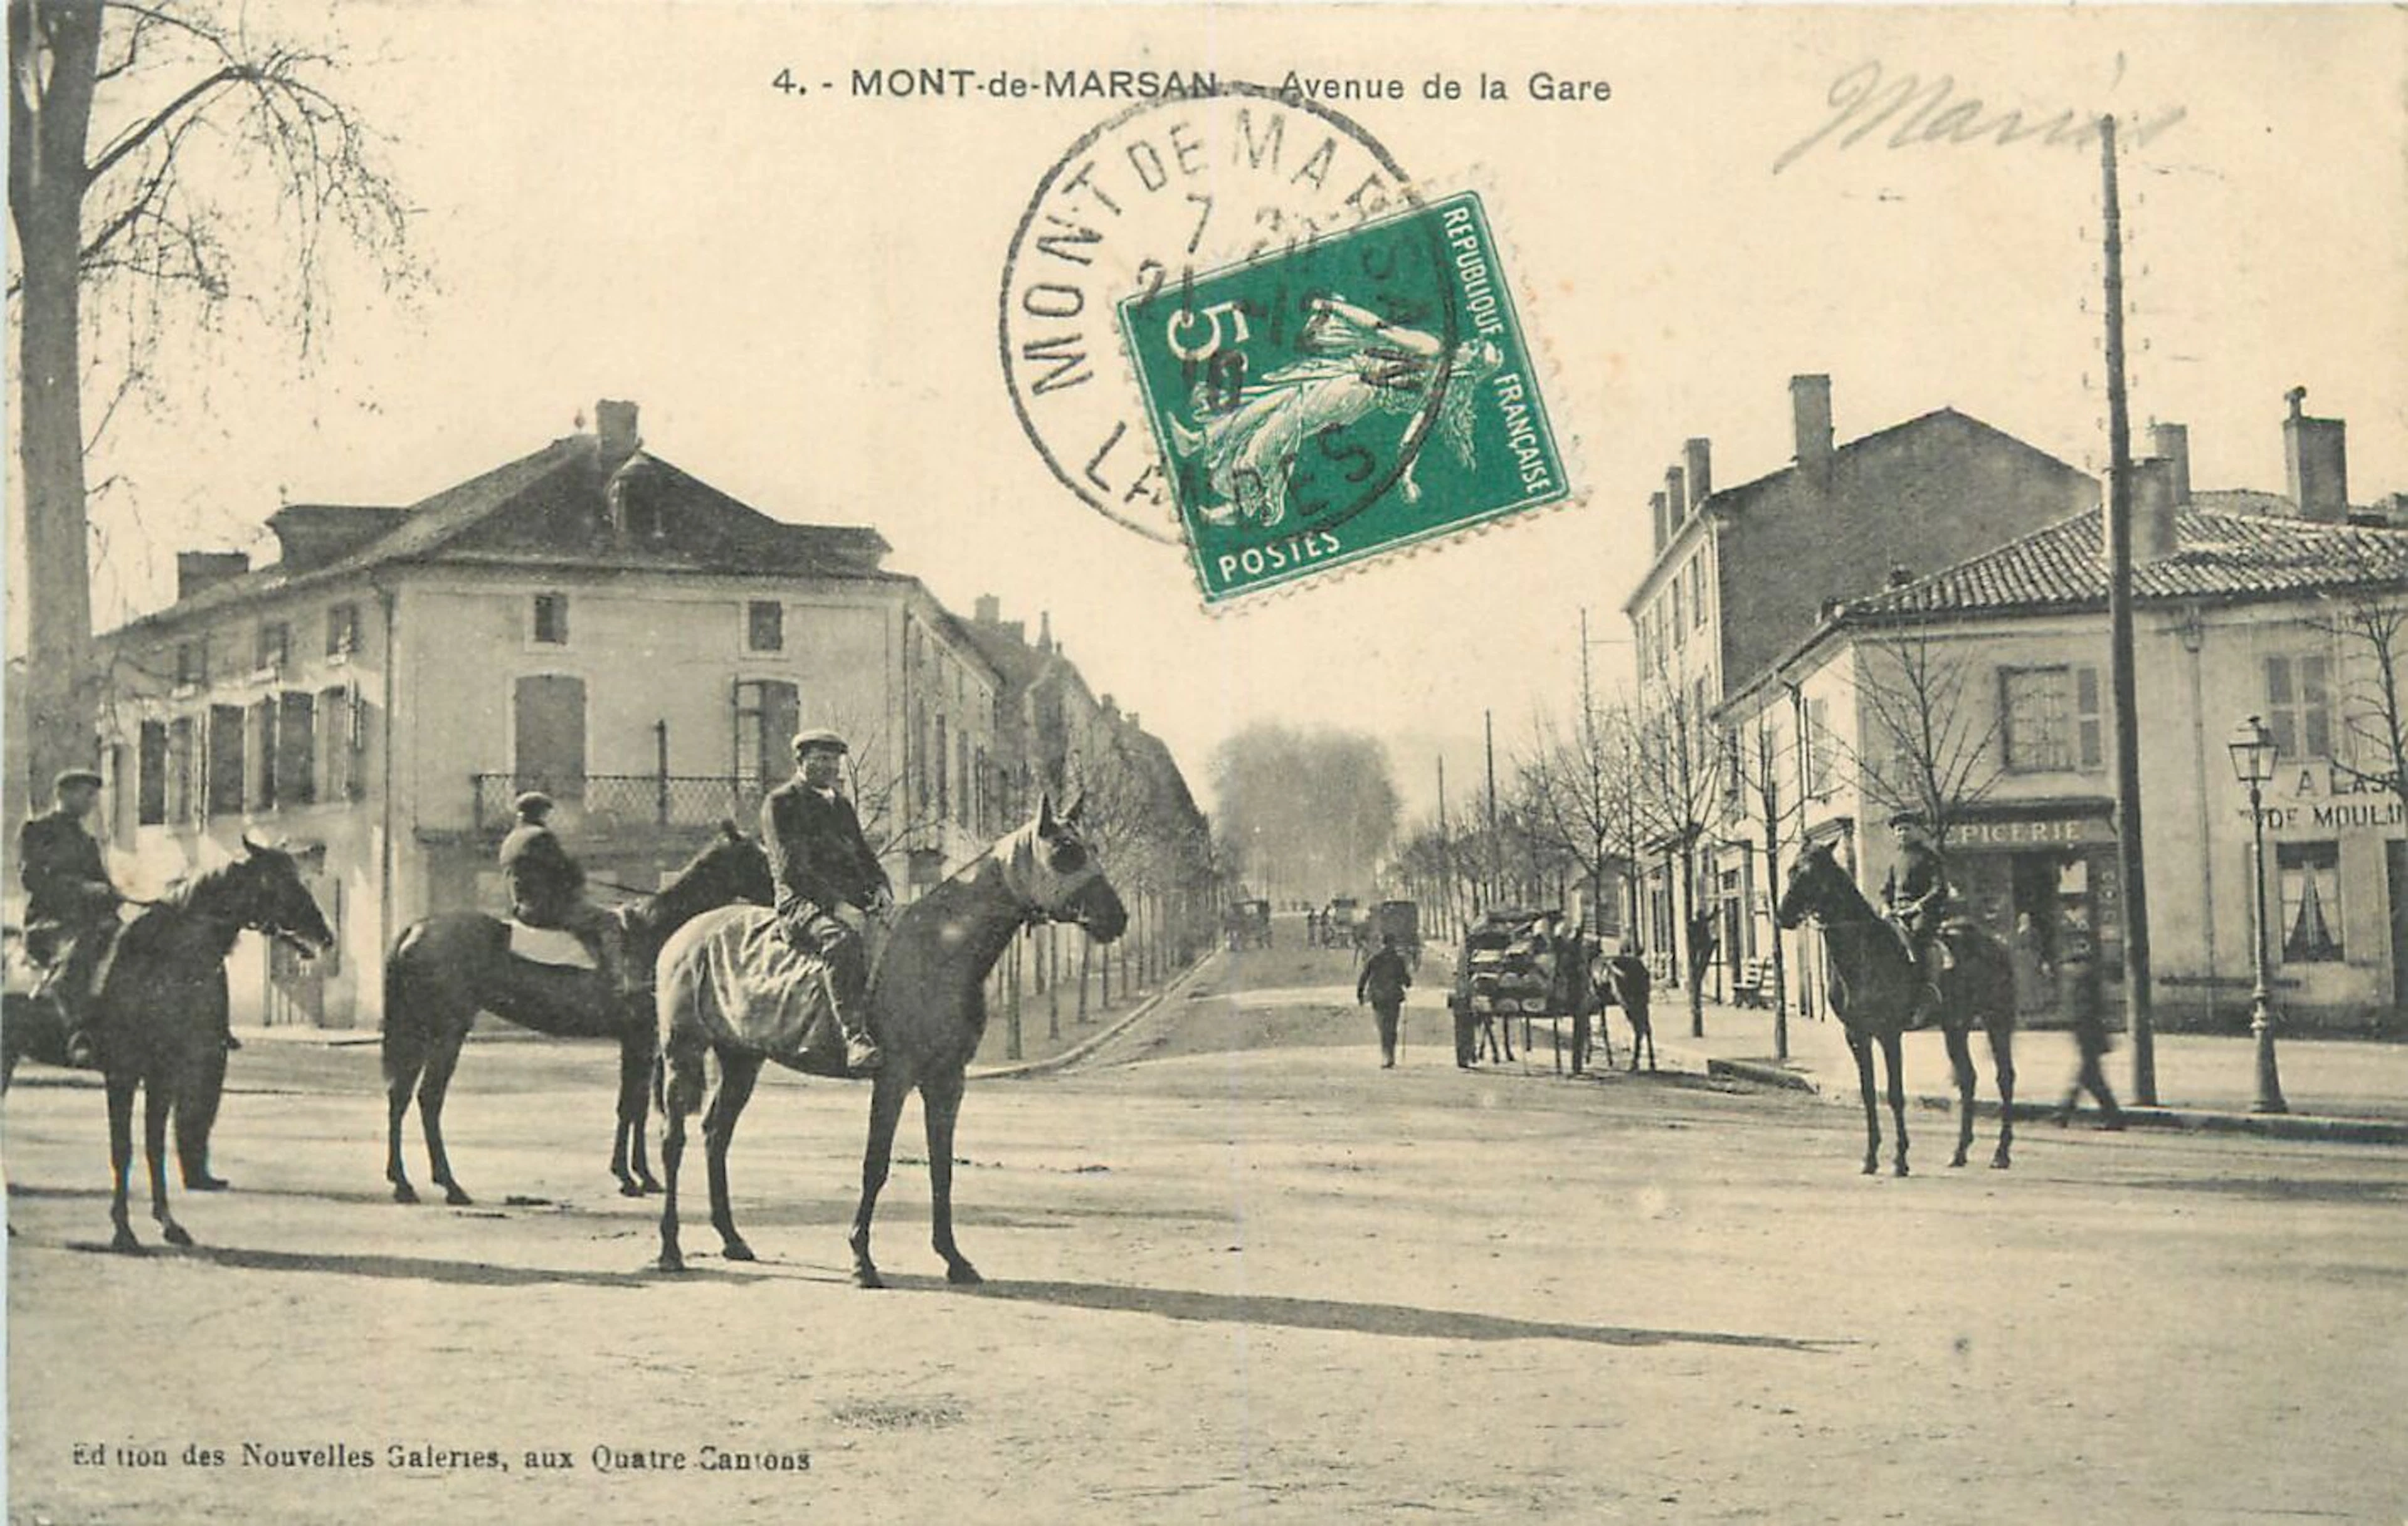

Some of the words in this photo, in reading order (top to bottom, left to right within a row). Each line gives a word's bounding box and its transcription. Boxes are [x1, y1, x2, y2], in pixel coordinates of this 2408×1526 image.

[1023, 160, 1121, 396] MONT
[1126, 123, 1207, 192] DE
[1166, 299, 1250, 362] 5
[1085, 420, 1376, 528] LADES
[1218, 530, 1342, 583] POSTES
